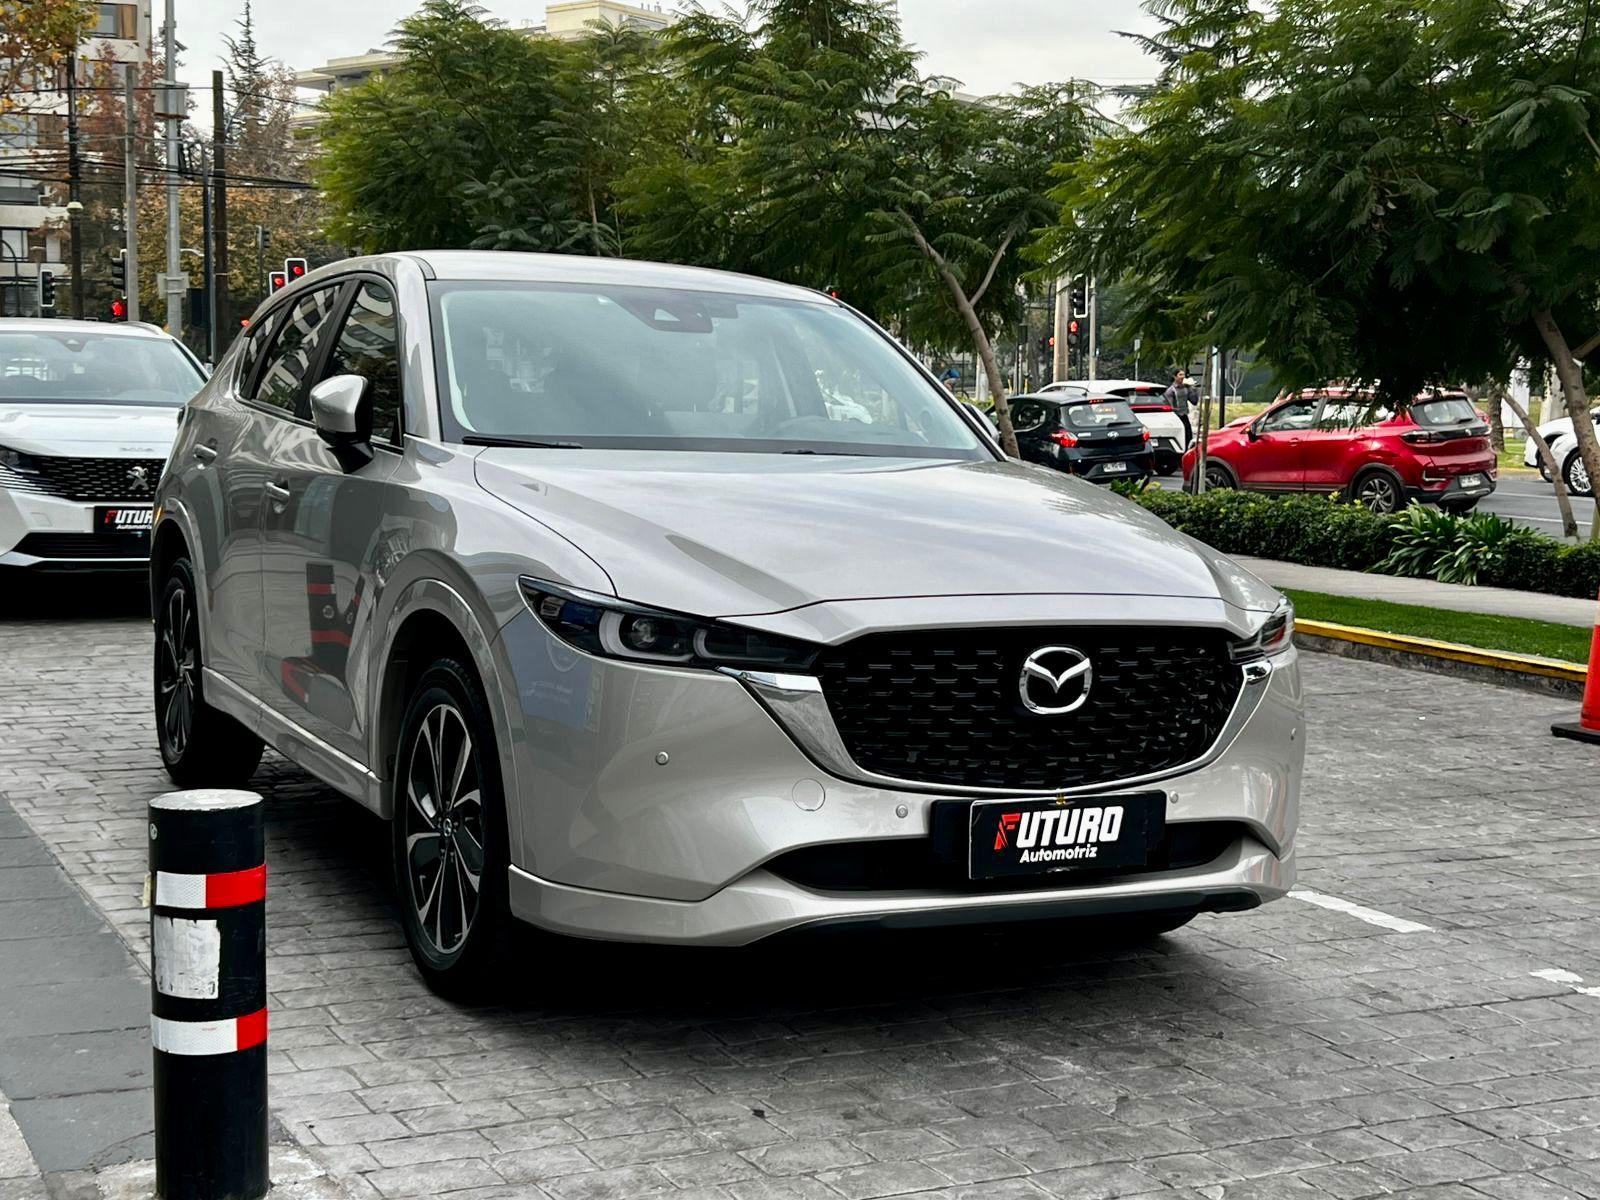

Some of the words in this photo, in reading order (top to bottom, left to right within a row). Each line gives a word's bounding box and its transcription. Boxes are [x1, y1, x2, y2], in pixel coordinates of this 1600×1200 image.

[105, 510, 153, 524] FUTUR
[994, 806, 1124, 850] FUTURO
[1019, 844, 1098, 863] Automotriz
